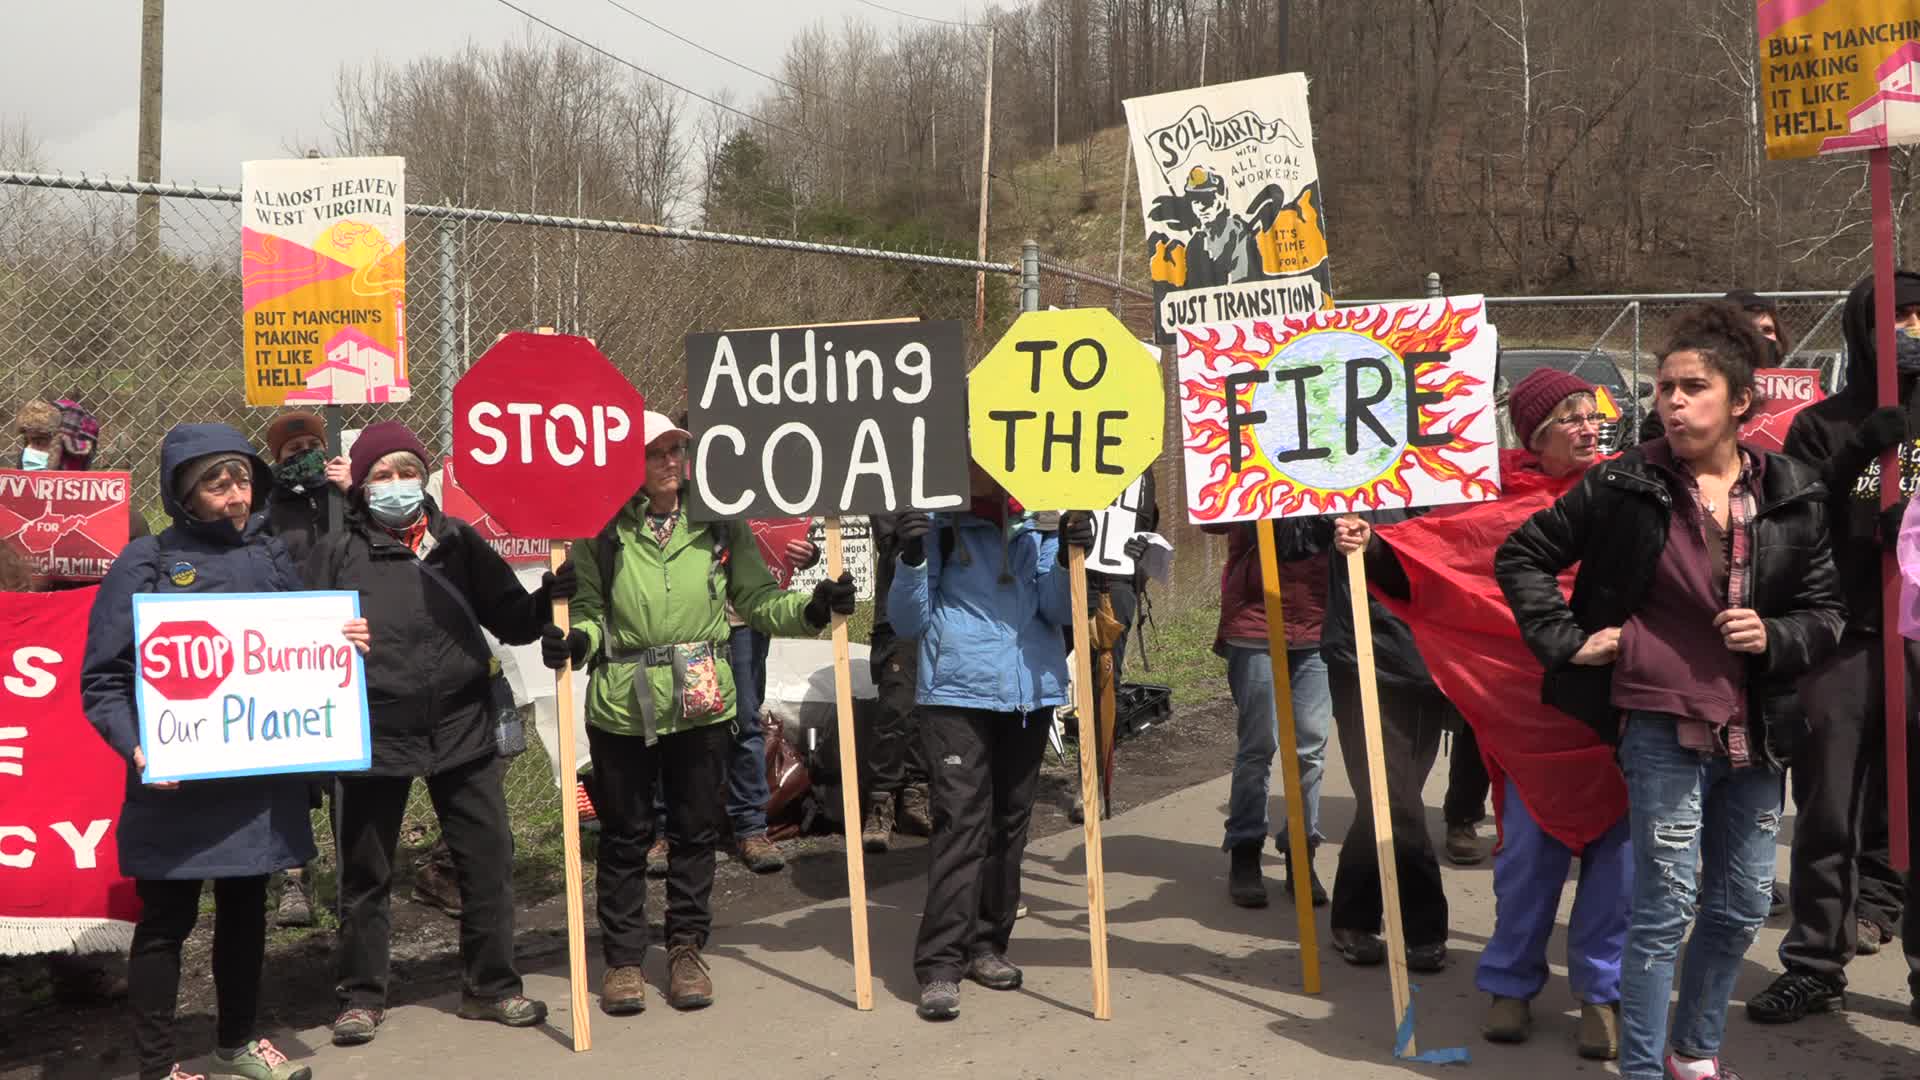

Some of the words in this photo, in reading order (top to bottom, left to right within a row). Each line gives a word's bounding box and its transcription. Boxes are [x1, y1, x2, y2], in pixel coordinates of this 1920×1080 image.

[1769, 34, 1813, 58] BUT
[1770, 54, 1858, 83] MAKING
[1771, 89, 1791, 109] IT
[1802, 82, 1850, 105] LIKE
[1775, 108, 1842, 137] HELL
[1158, 112, 1279, 168] SOLIDARITY
[1235, 145, 1258, 157] WITH
[1230, 159, 1256, 177] ALL
[1264, 152, 1301, 168] COAL
[254, 185, 324, 208] ALMOST
[332, 177, 397, 199] HEAVEN
[1234, 169, 1299, 189] WORKERS
[256, 208, 304, 226] WEST
[313, 198, 393, 221] VIRGINIA
[1274, 228, 1297, 241] IT'S
[1276, 240, 1305, 252] TIME
[1278, 258, 1297, 268] FOR
[1302, 257, 1309, 265] A
[254, 311, 286, 326] BUT
[293, 309, 382, 325] MANCHIN'S
[1167, 294, 1207, 326] JUST
[1214, 283, 1316, 321] TRANSITION
[255, 330, 319, 345] MAKING
[255, 350, 272, 365] IT
[277, 349, 313, 365] LIKE
[700, 329, 933, 409] Adding
[1014, 337, 1108, 394] TO
[257, 368, 308, 387] HELL
[1224, 351, 1455, 473] FIRE
[468, 401, 631, 467] STOP
[988, 409, 1129, 476] THE
[694, 416, 964, 515] COAL
[37, 479, 123, 501] RISING
[37, 522, 60, 532] FOR
[55, 557, 114, 575] FAMILIE
[143, 634, 229, 680] STOP
[243, 629, 353, 688] Burning
[158, 708, 207, 744] Our
[222, 694, 336, 744] Planet
